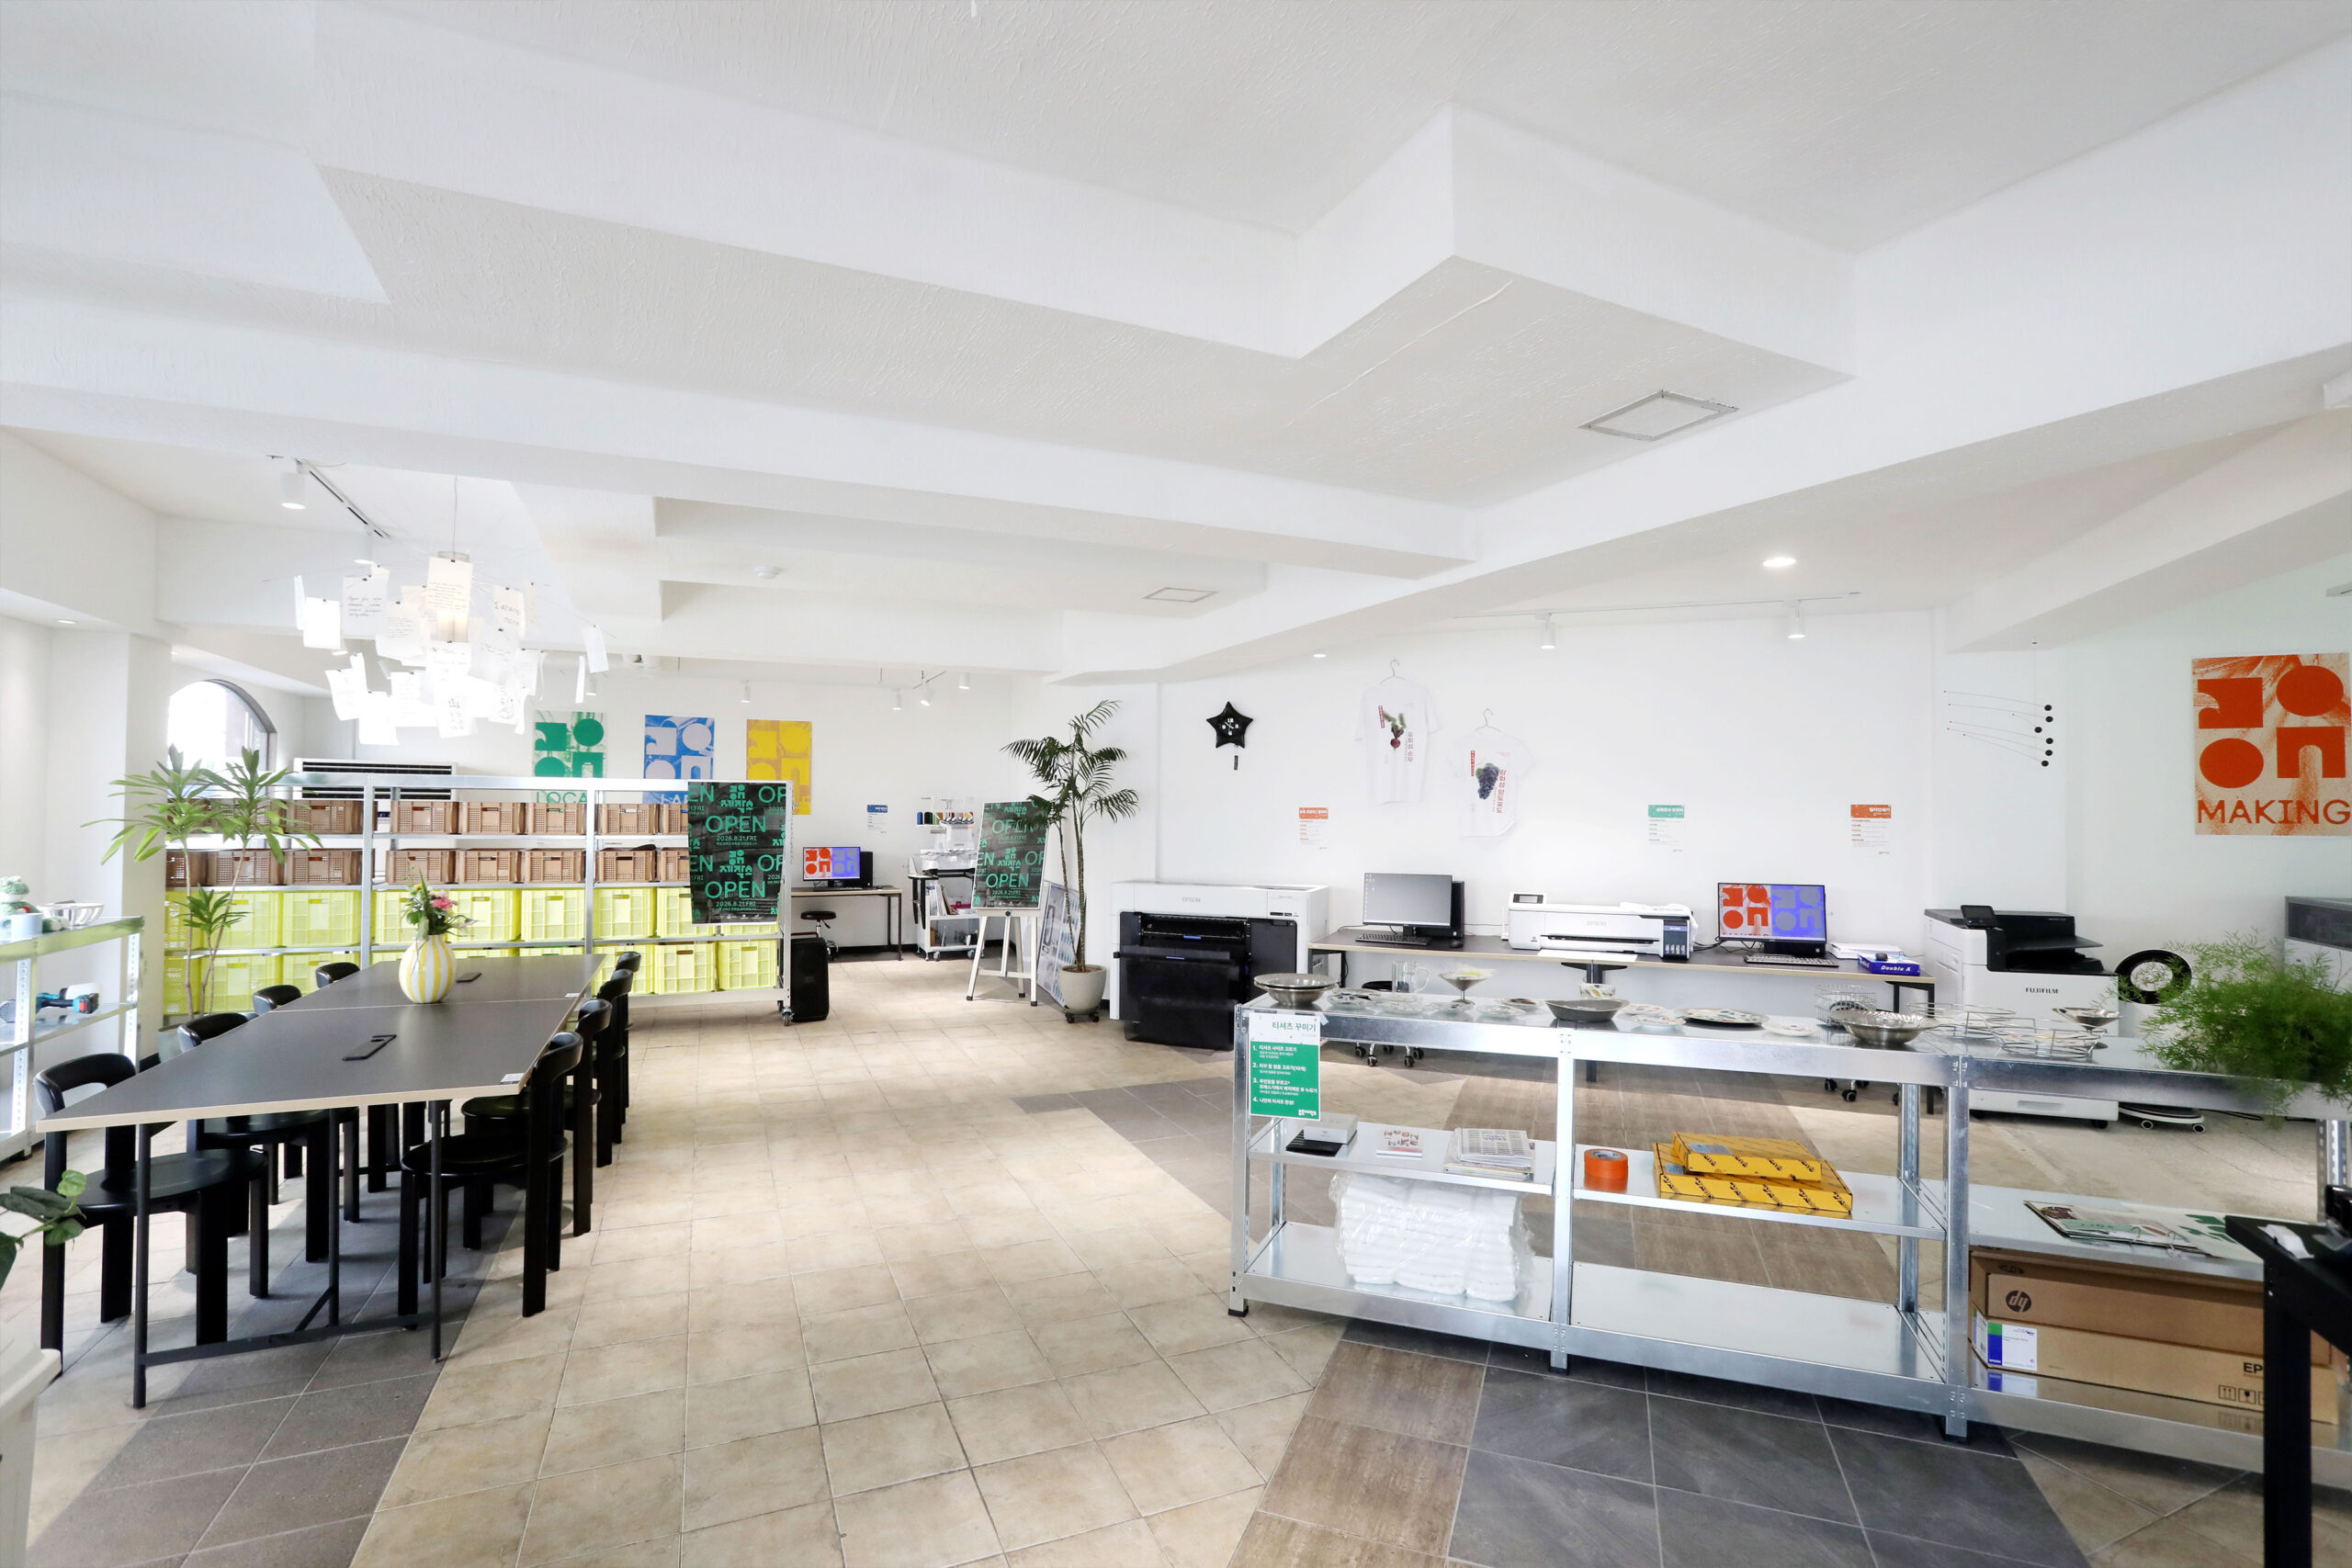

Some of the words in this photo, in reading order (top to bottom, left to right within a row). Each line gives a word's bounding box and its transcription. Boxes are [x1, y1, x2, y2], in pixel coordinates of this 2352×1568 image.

[2197, 799, 2351, 825] MAKING
[706, 815, 766, 833] OPEN
[986, 873, 1029, 888] OPEN
[705, 881, 766, 899] OPEN
[2025, 987, 2059, 995] FUJIFILM
[1272, 1021, 1294, 1030] 티셔츠
[1295, 1023, 1317, 1032] 꾸미기
